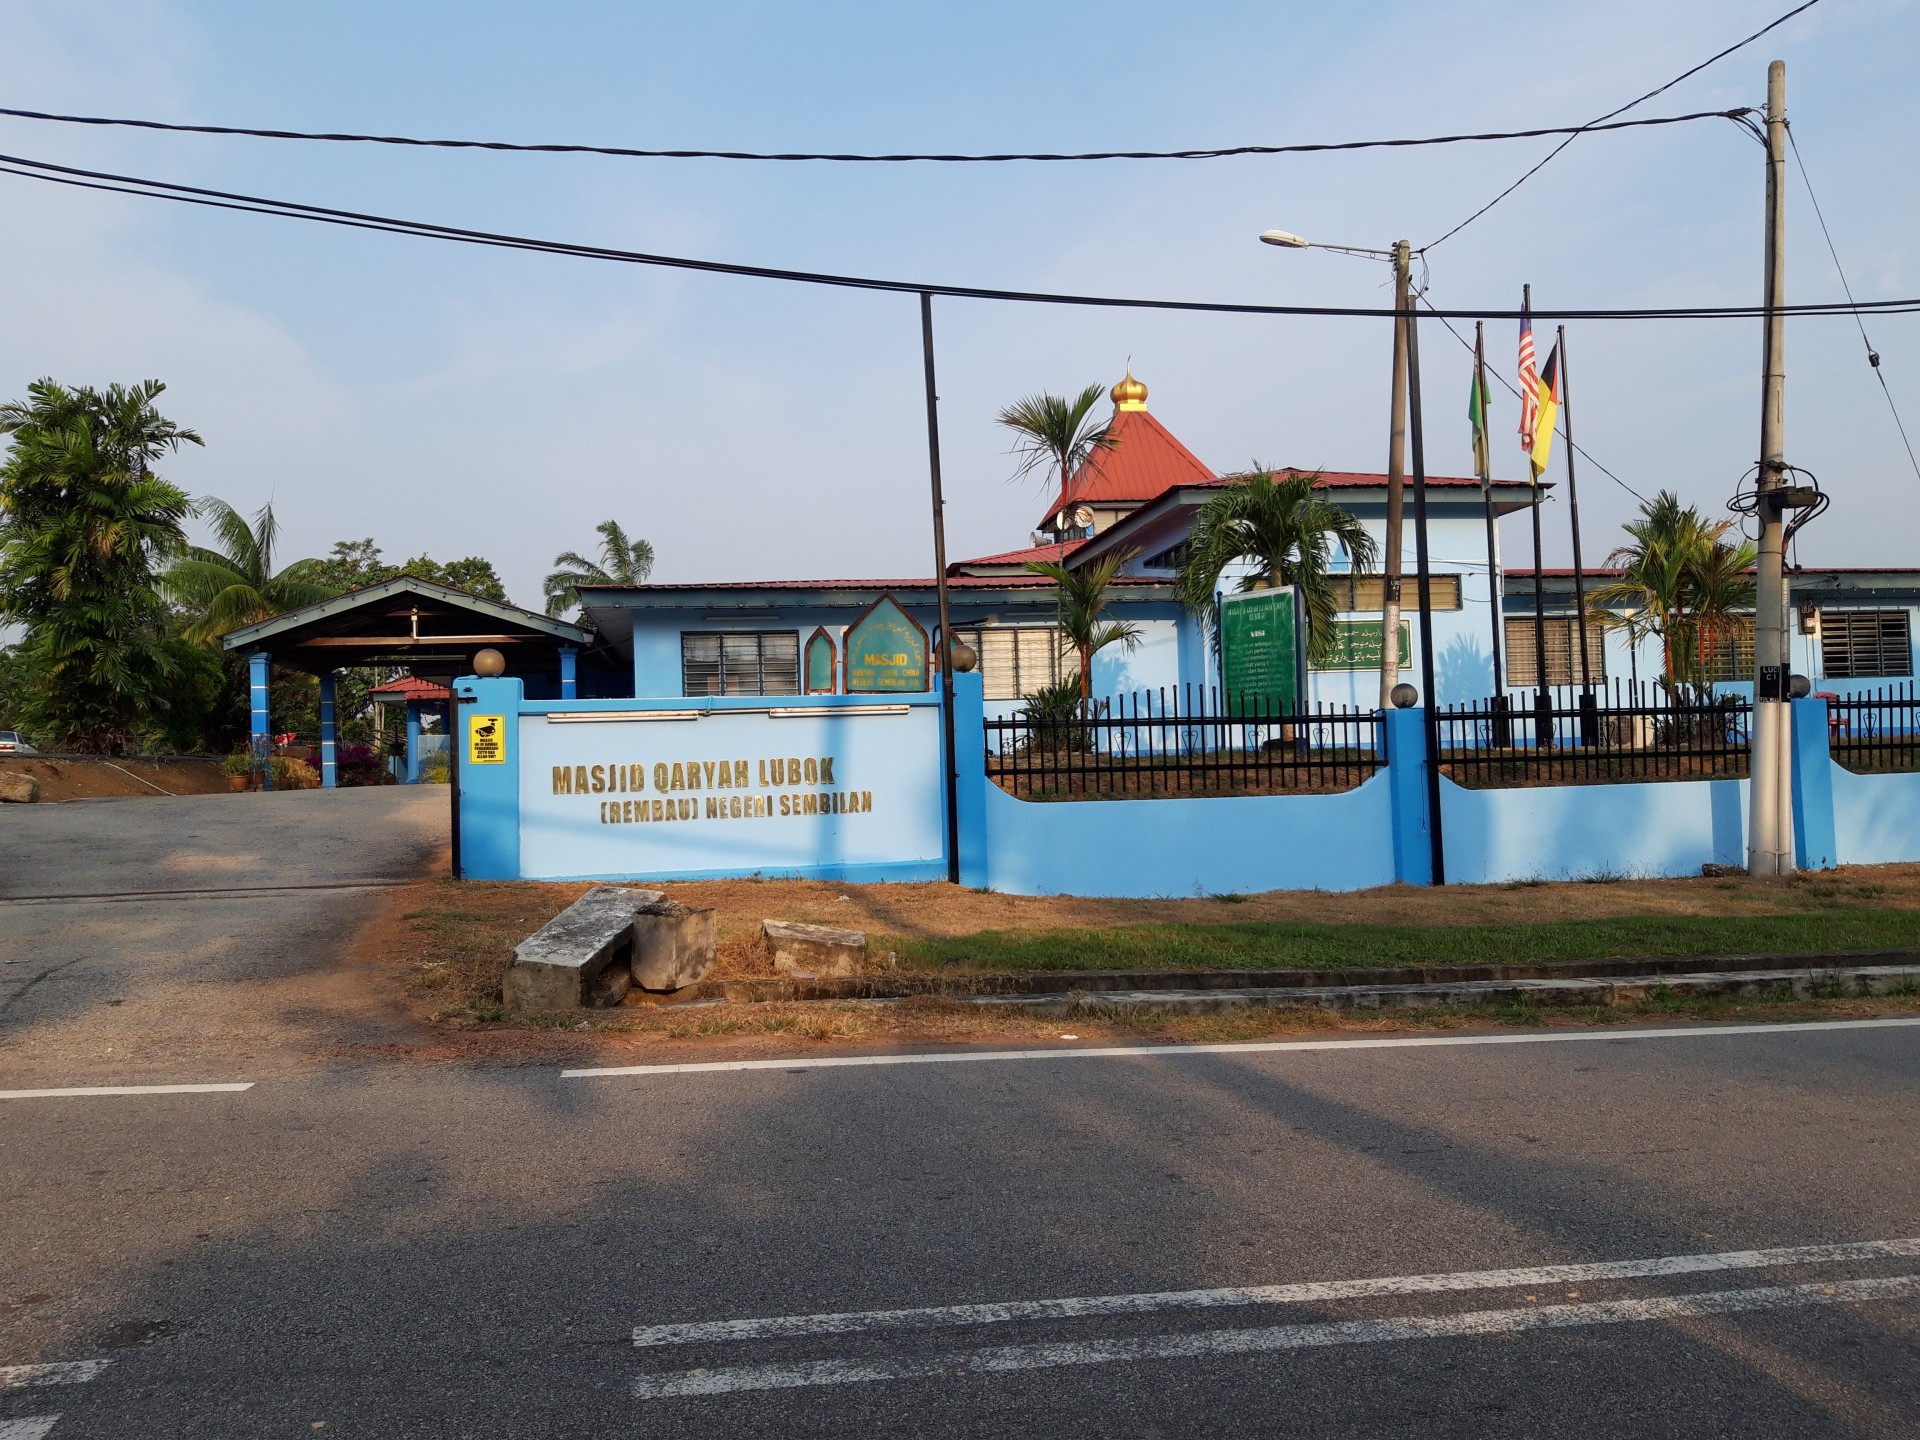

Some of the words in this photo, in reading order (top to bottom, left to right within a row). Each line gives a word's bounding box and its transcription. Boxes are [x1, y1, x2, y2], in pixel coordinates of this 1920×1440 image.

[864, 653, 908, 666] MASJID
[552, 763, 645, 795] MASJID
[653, 759, 749, 794] QARYAH
[758, 756, 835, 787] LUBOK
[706, 793, 773, 819] NEGERI
[779, 790, 872, 816] SEMBILAN
